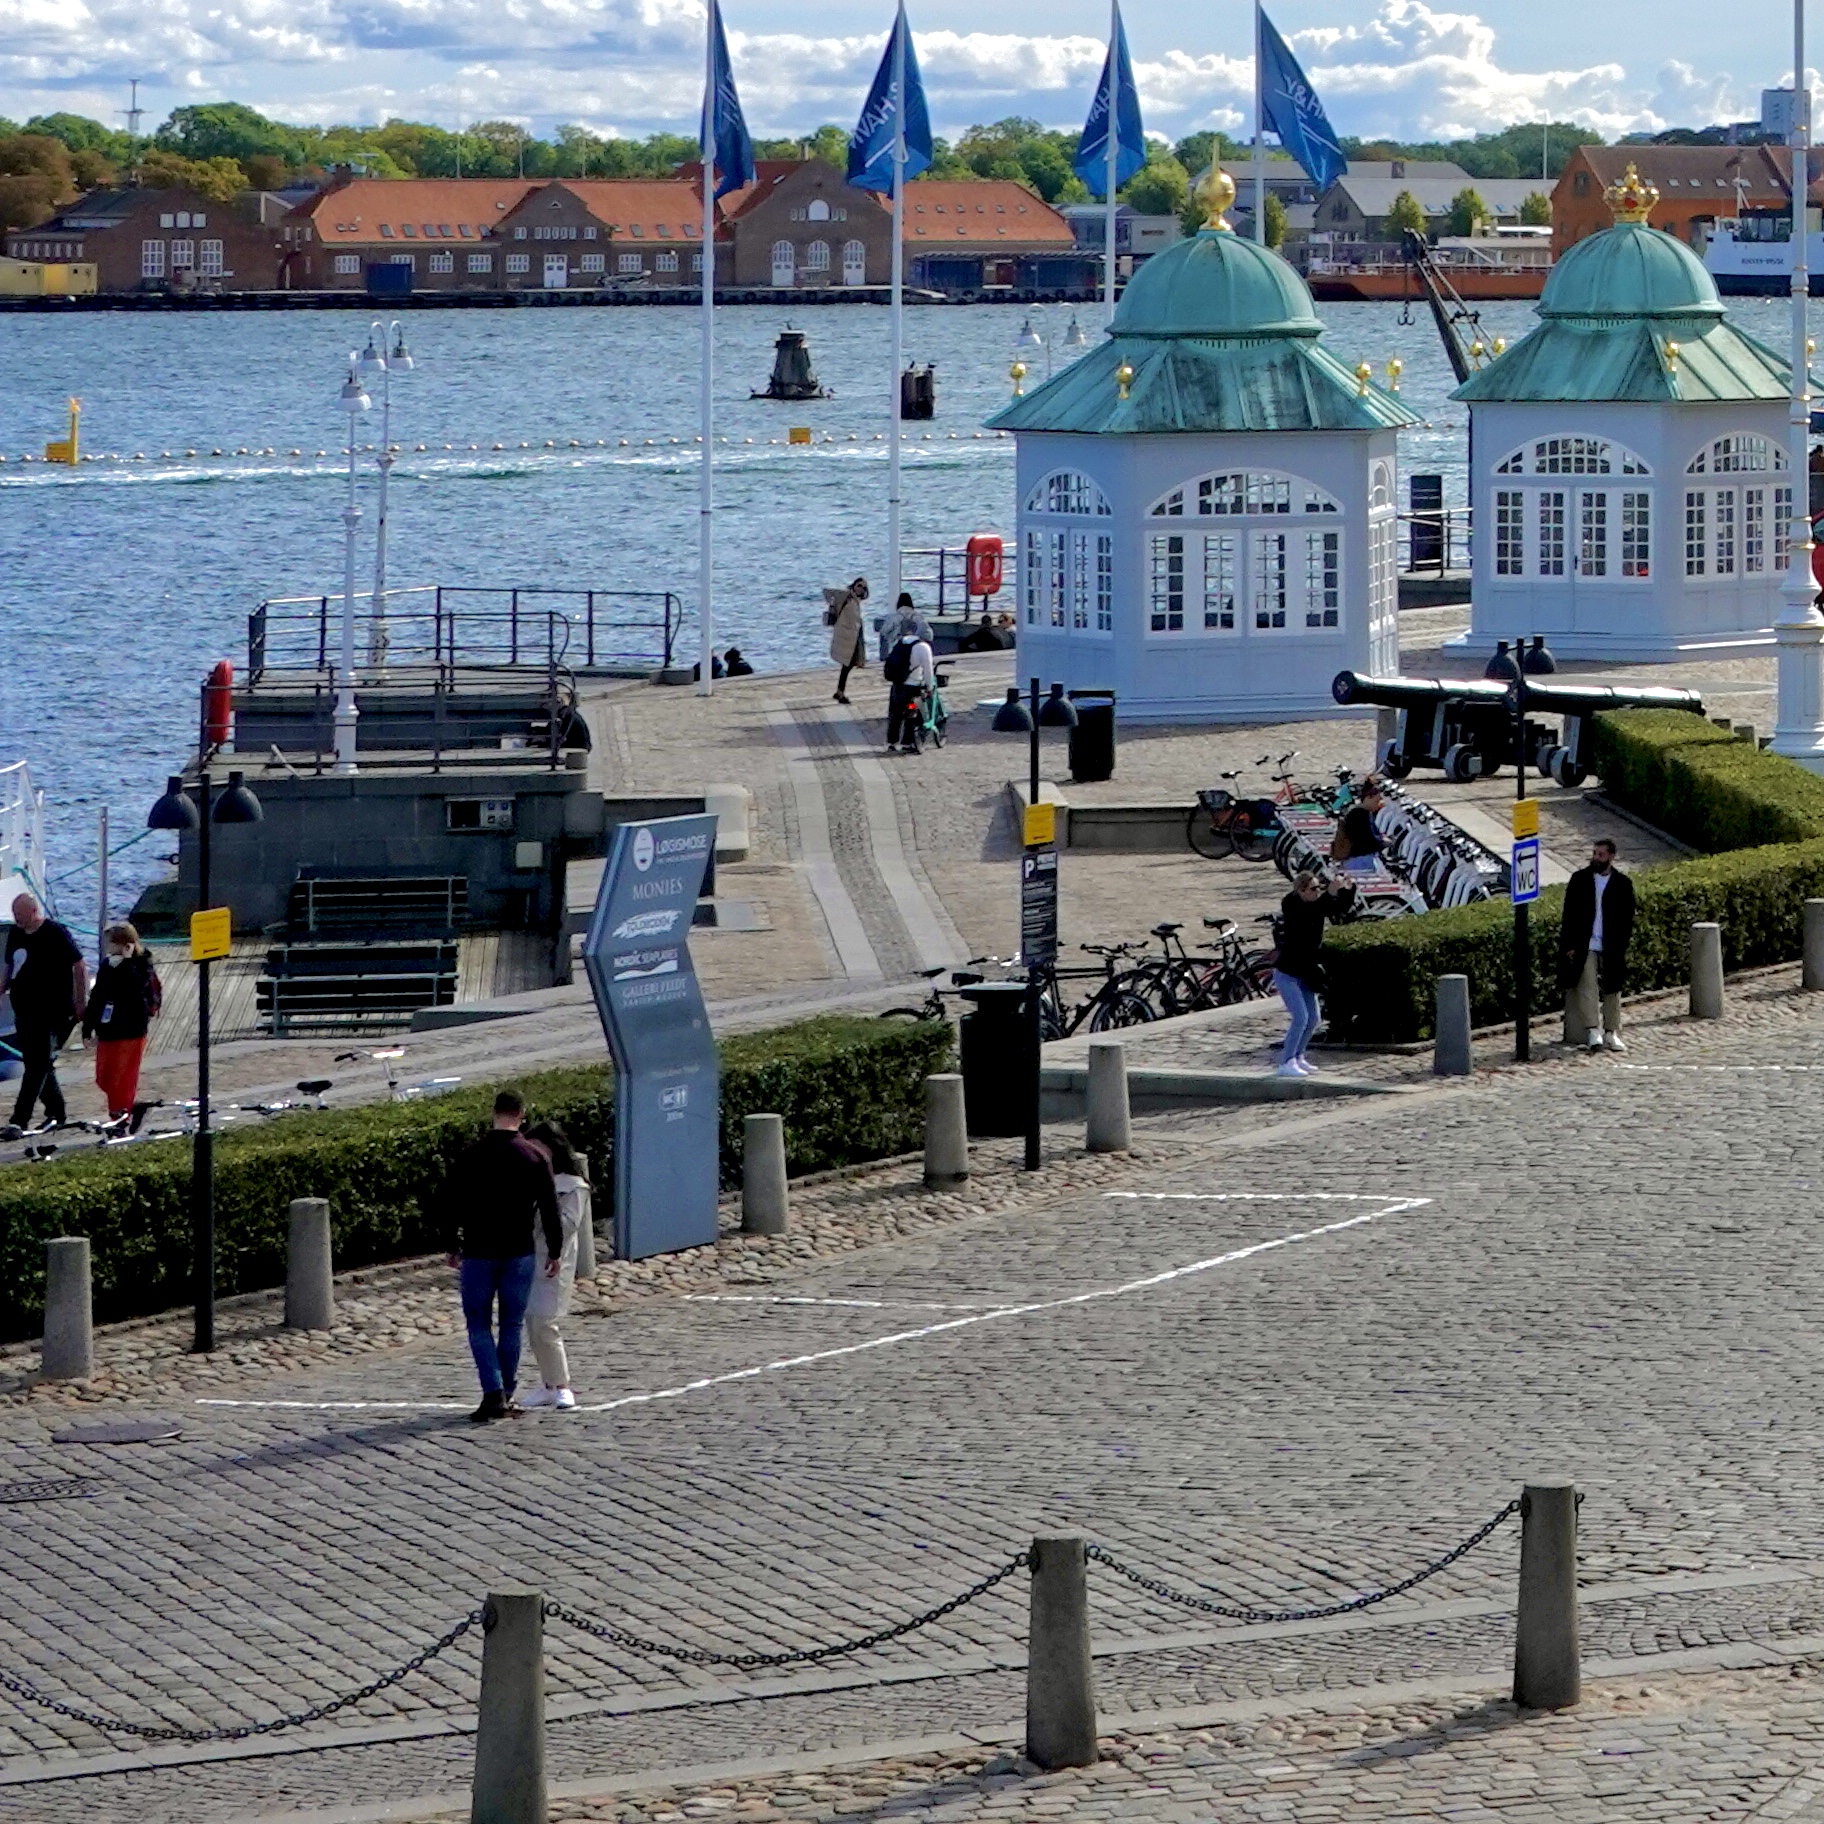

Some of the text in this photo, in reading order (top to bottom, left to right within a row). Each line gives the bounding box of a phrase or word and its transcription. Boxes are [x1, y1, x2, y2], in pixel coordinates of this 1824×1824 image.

[1025, 859, 1035, 879] P
[633, 878, 683, 900] MONIES
[1517, 869, 1536, 892] WC
